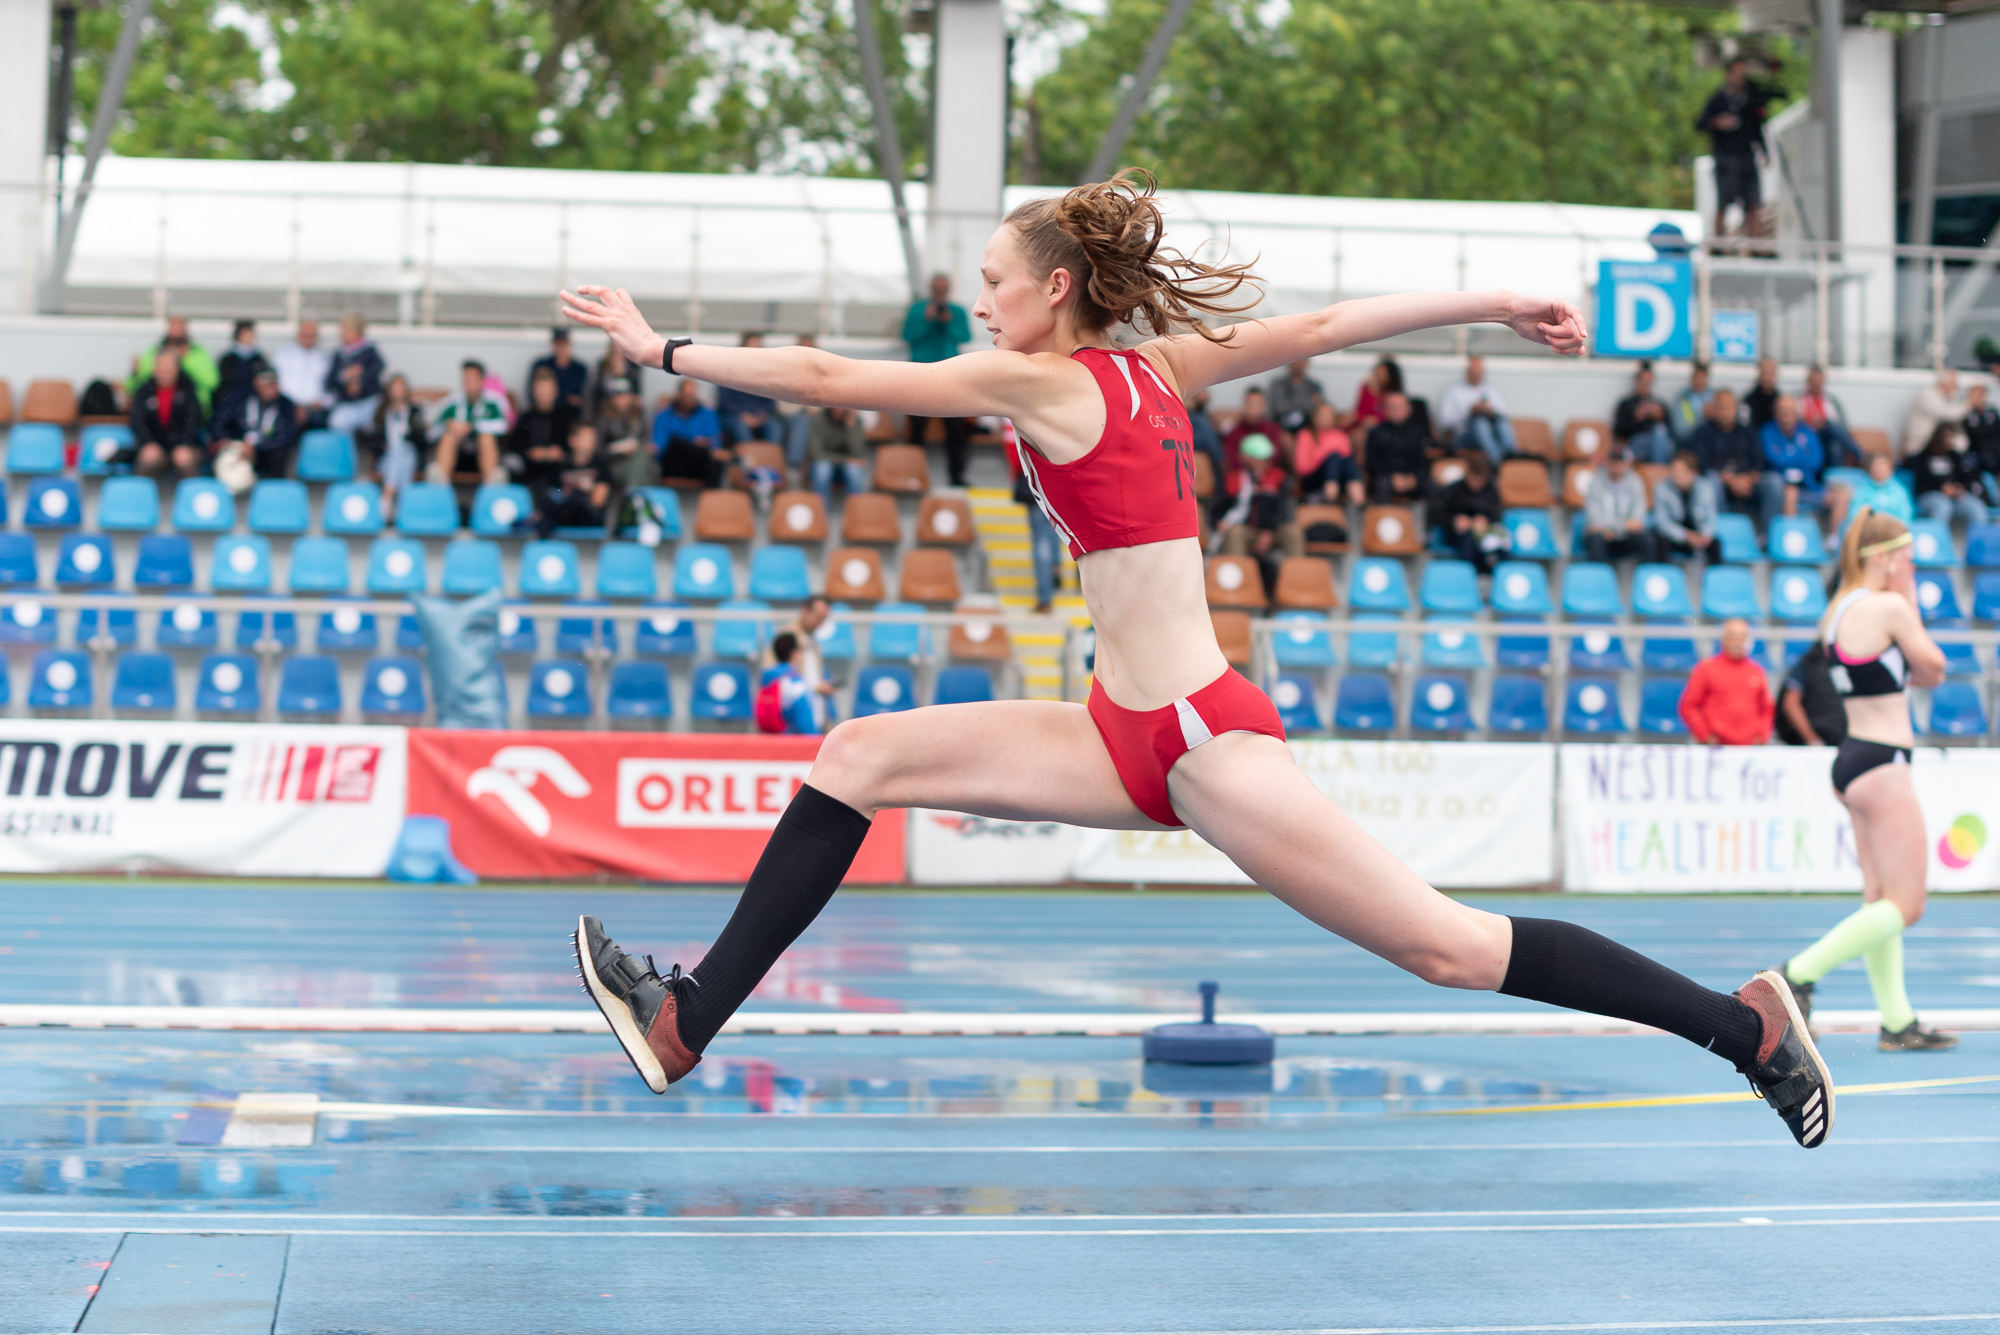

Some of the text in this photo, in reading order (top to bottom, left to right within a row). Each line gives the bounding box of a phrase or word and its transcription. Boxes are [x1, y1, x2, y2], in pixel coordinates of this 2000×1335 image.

[1614, 282, 1676, 351] D
[1739, 758, 1787, 802] for
[1590, 818, 1815, 873] HEALTHIER
